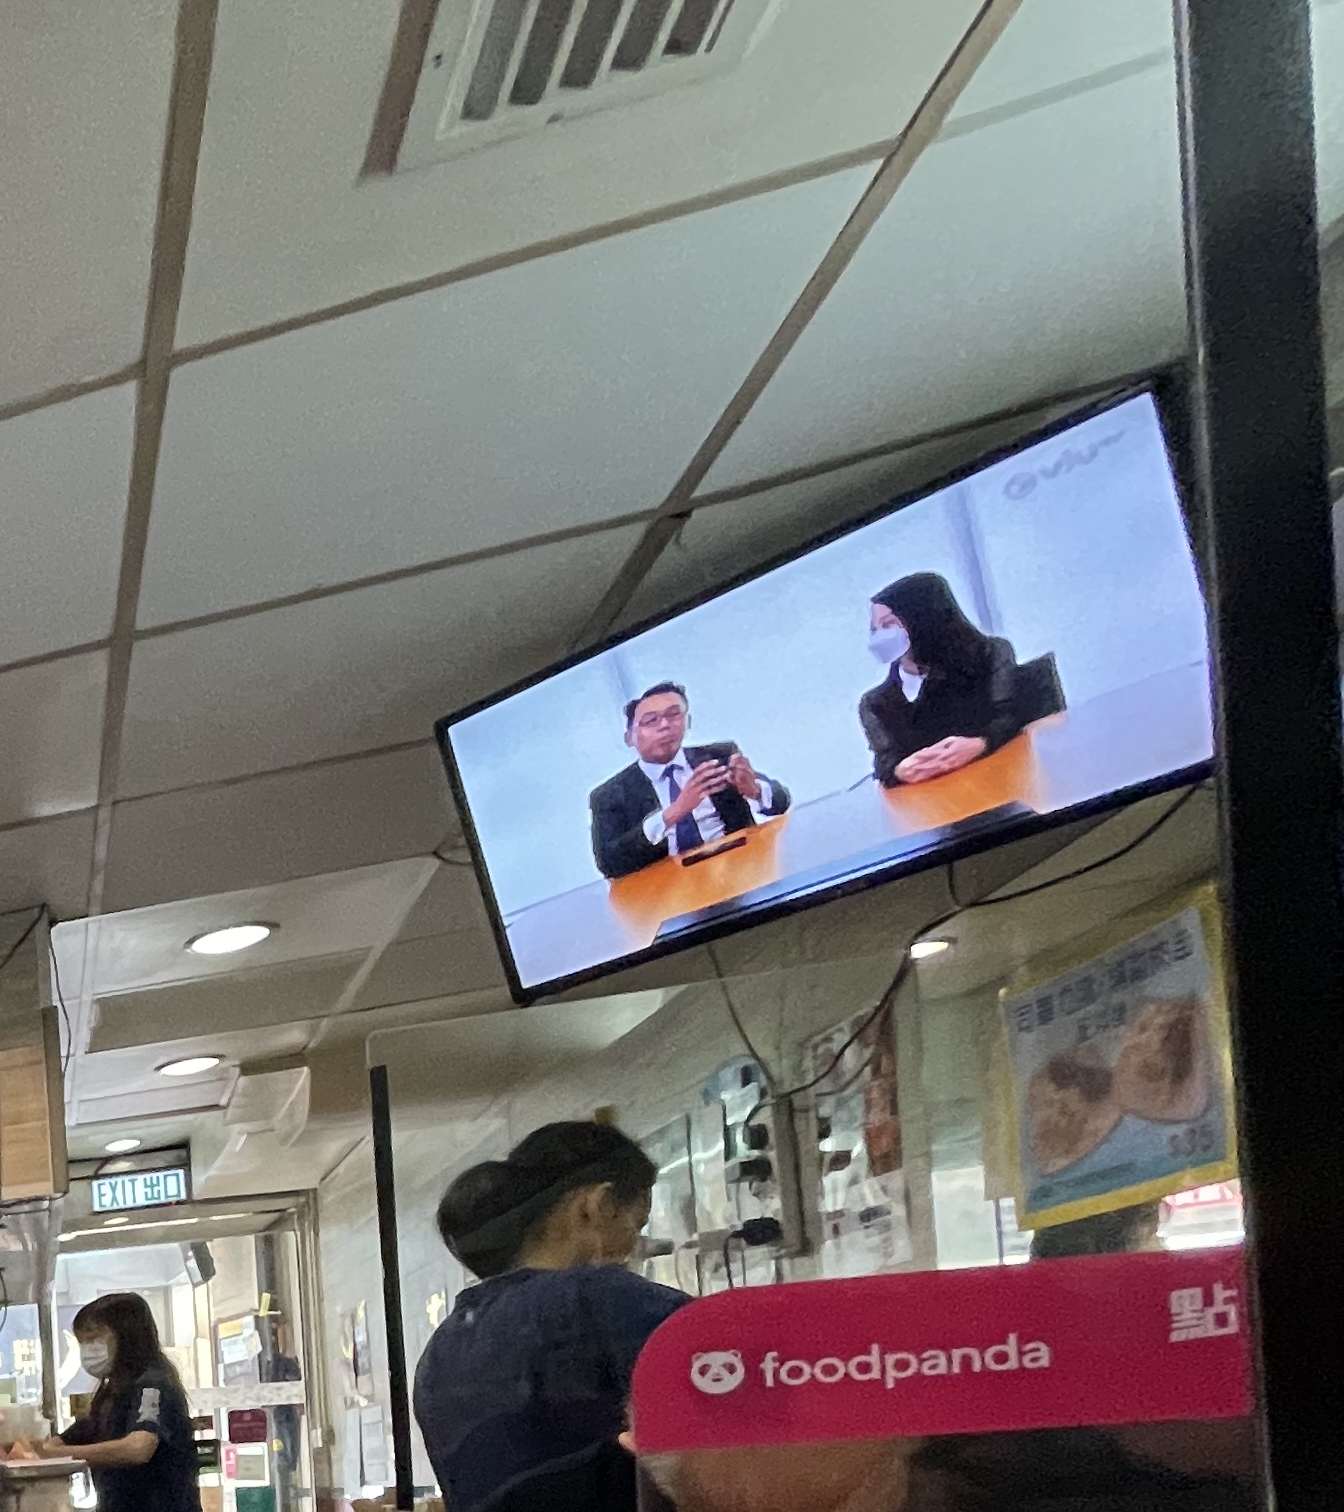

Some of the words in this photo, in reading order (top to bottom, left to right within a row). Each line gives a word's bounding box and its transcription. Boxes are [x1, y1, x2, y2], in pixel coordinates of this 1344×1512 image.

[97, 1177, 139, 1210] EXIT
[143, 1172, 182, 1201] 出口
[1169, 1282, 1239, 1343] 點
[759, 1332, 1052, 1388] foodpanda
